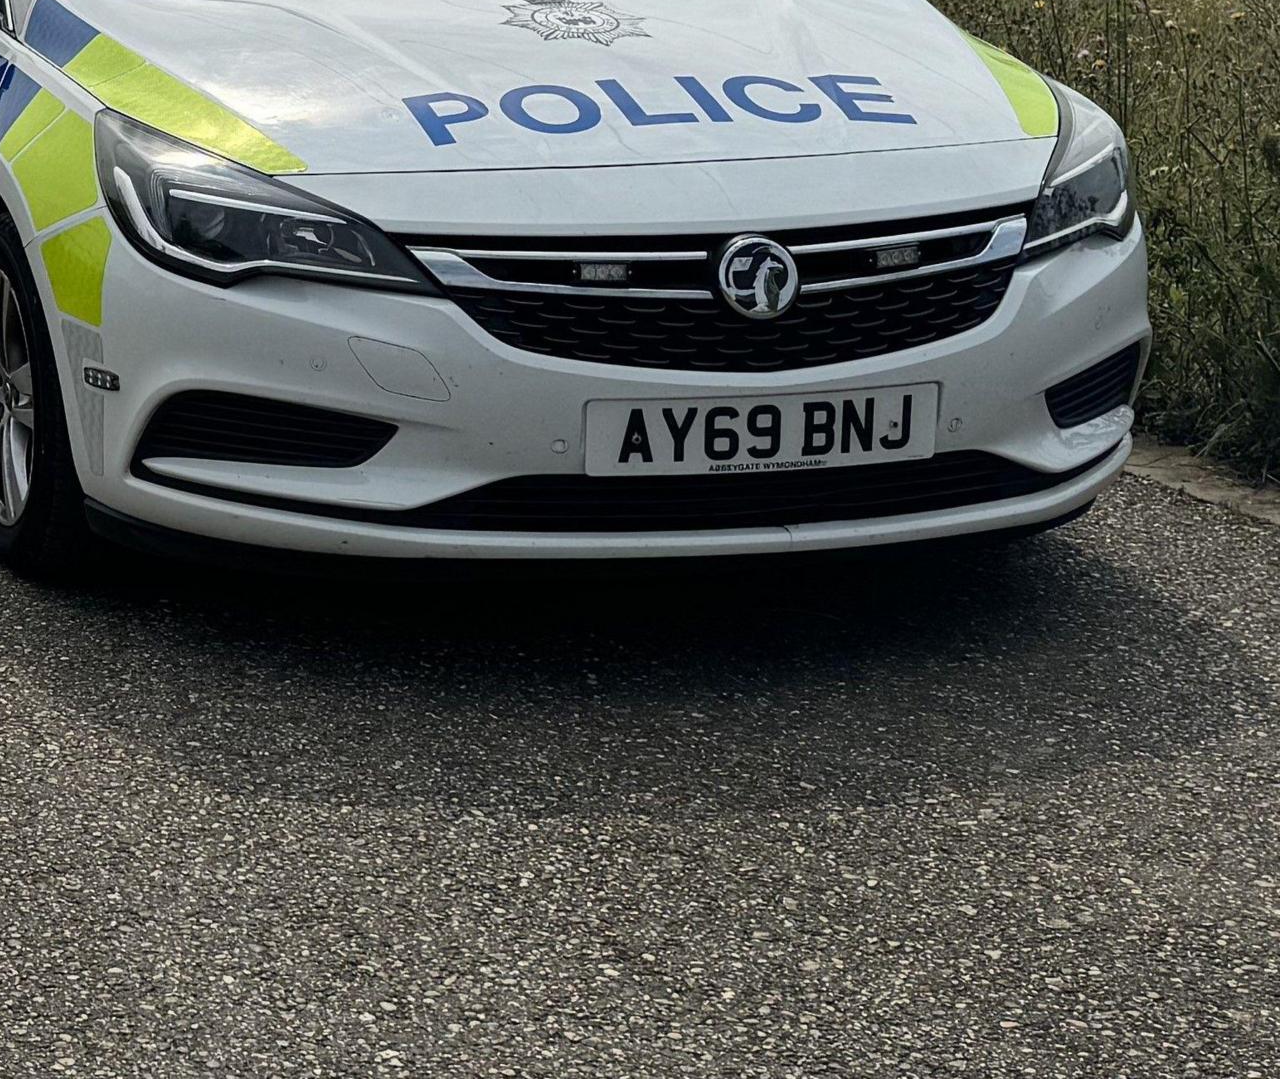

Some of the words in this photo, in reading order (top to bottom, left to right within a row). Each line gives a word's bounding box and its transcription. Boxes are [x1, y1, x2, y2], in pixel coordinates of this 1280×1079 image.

[402, 74, 917, 146] POLICE
[617, 407, 781, 463] AY69
[800, 394, 913, 457] BNJ
